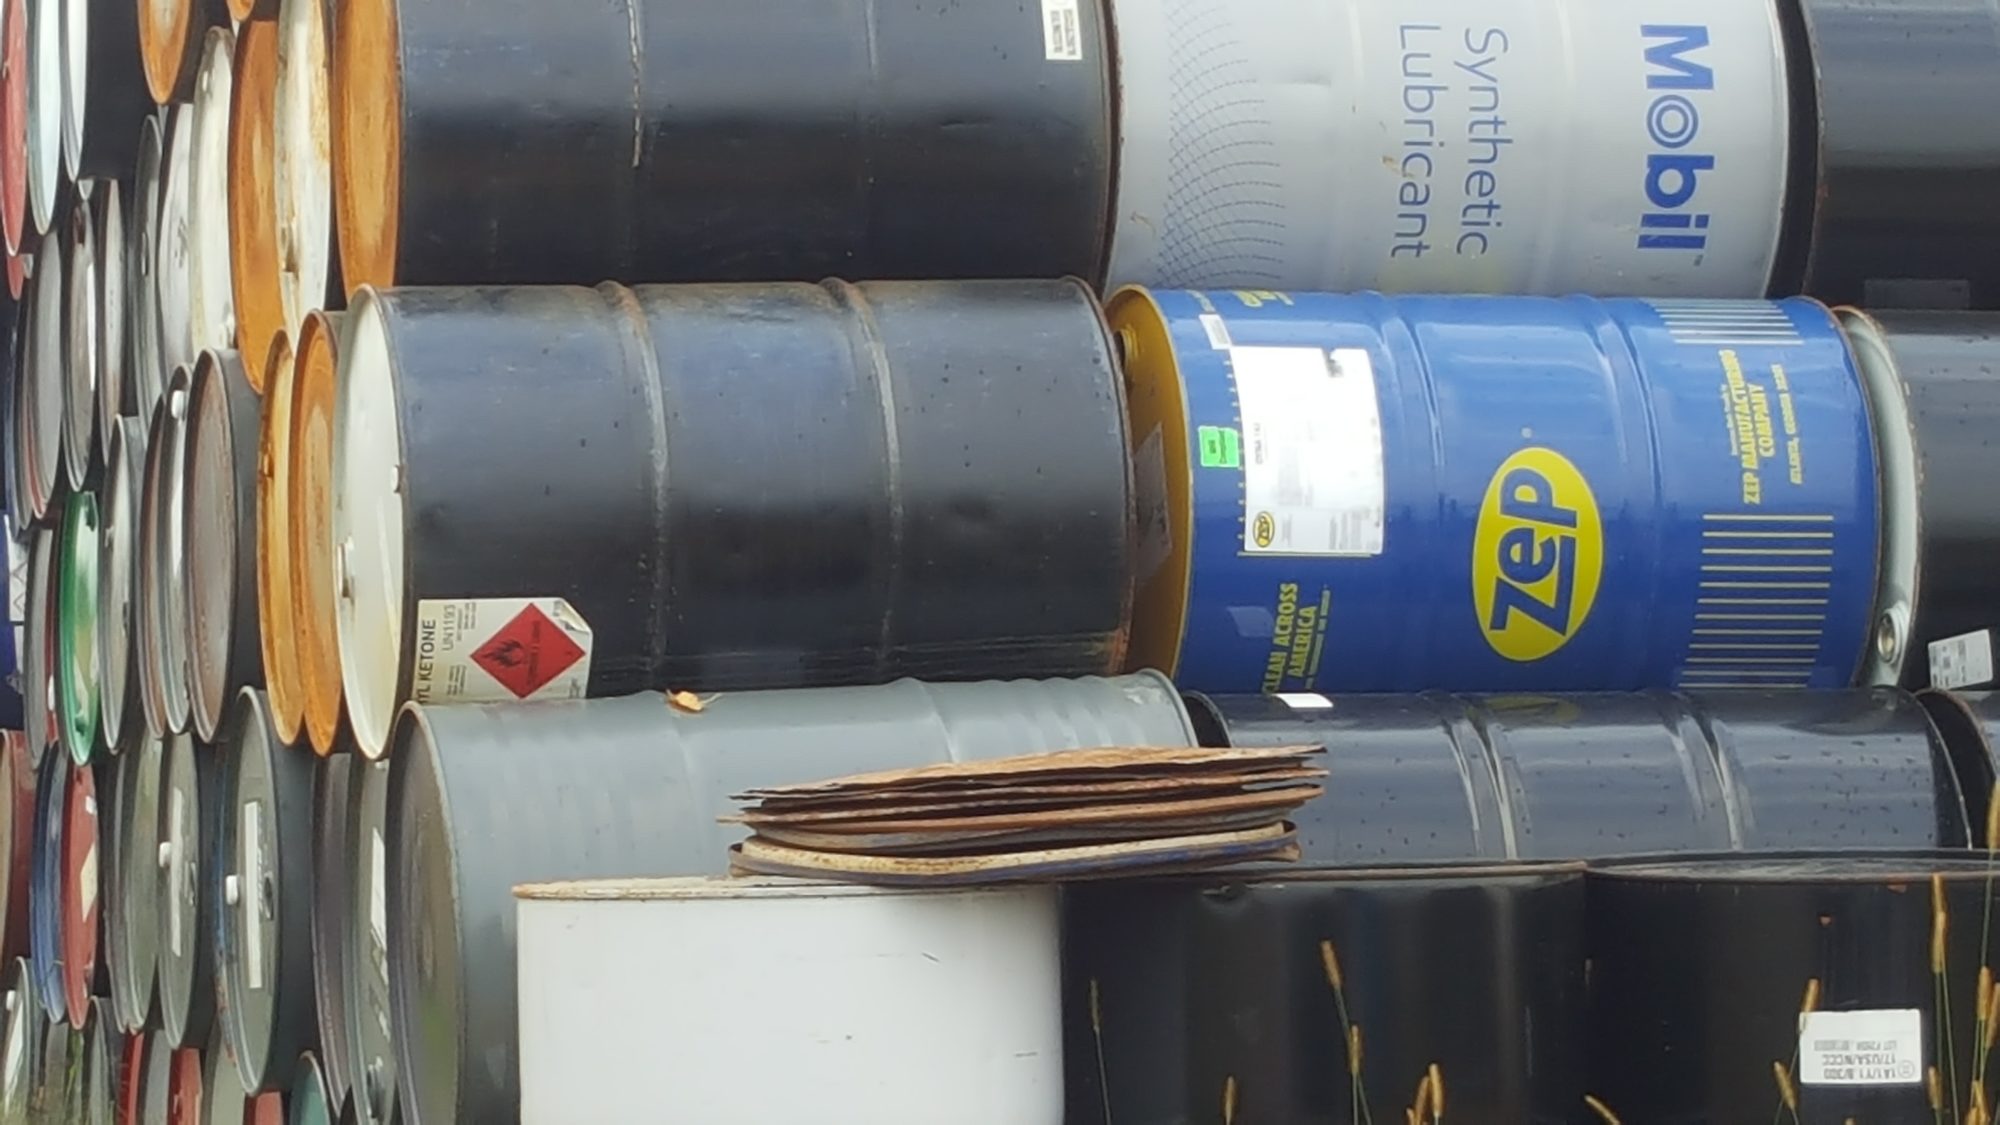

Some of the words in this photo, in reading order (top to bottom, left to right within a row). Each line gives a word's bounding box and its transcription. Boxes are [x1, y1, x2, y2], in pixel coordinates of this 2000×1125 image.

[1390, 25, 1449, 257] Lubricant
[1453, 28, 1513, 255] Synthetic
[1638, 24, 1713, 249] Mobil
[1718, 349, 1758, 470] MANUFACTURING
[1747, 383, 1775, 458] COMPANY
[1742, 471, 1760, 504] ZEP
[418, 619, 436, 681] KETONE
[441, 603, 456, 652] UN1193
[1273, 583, 1298, 646] ACROSS
[1287, 606, 1318, 677] AMERICA
[1261, 651, 1288, 694] CLEAN
